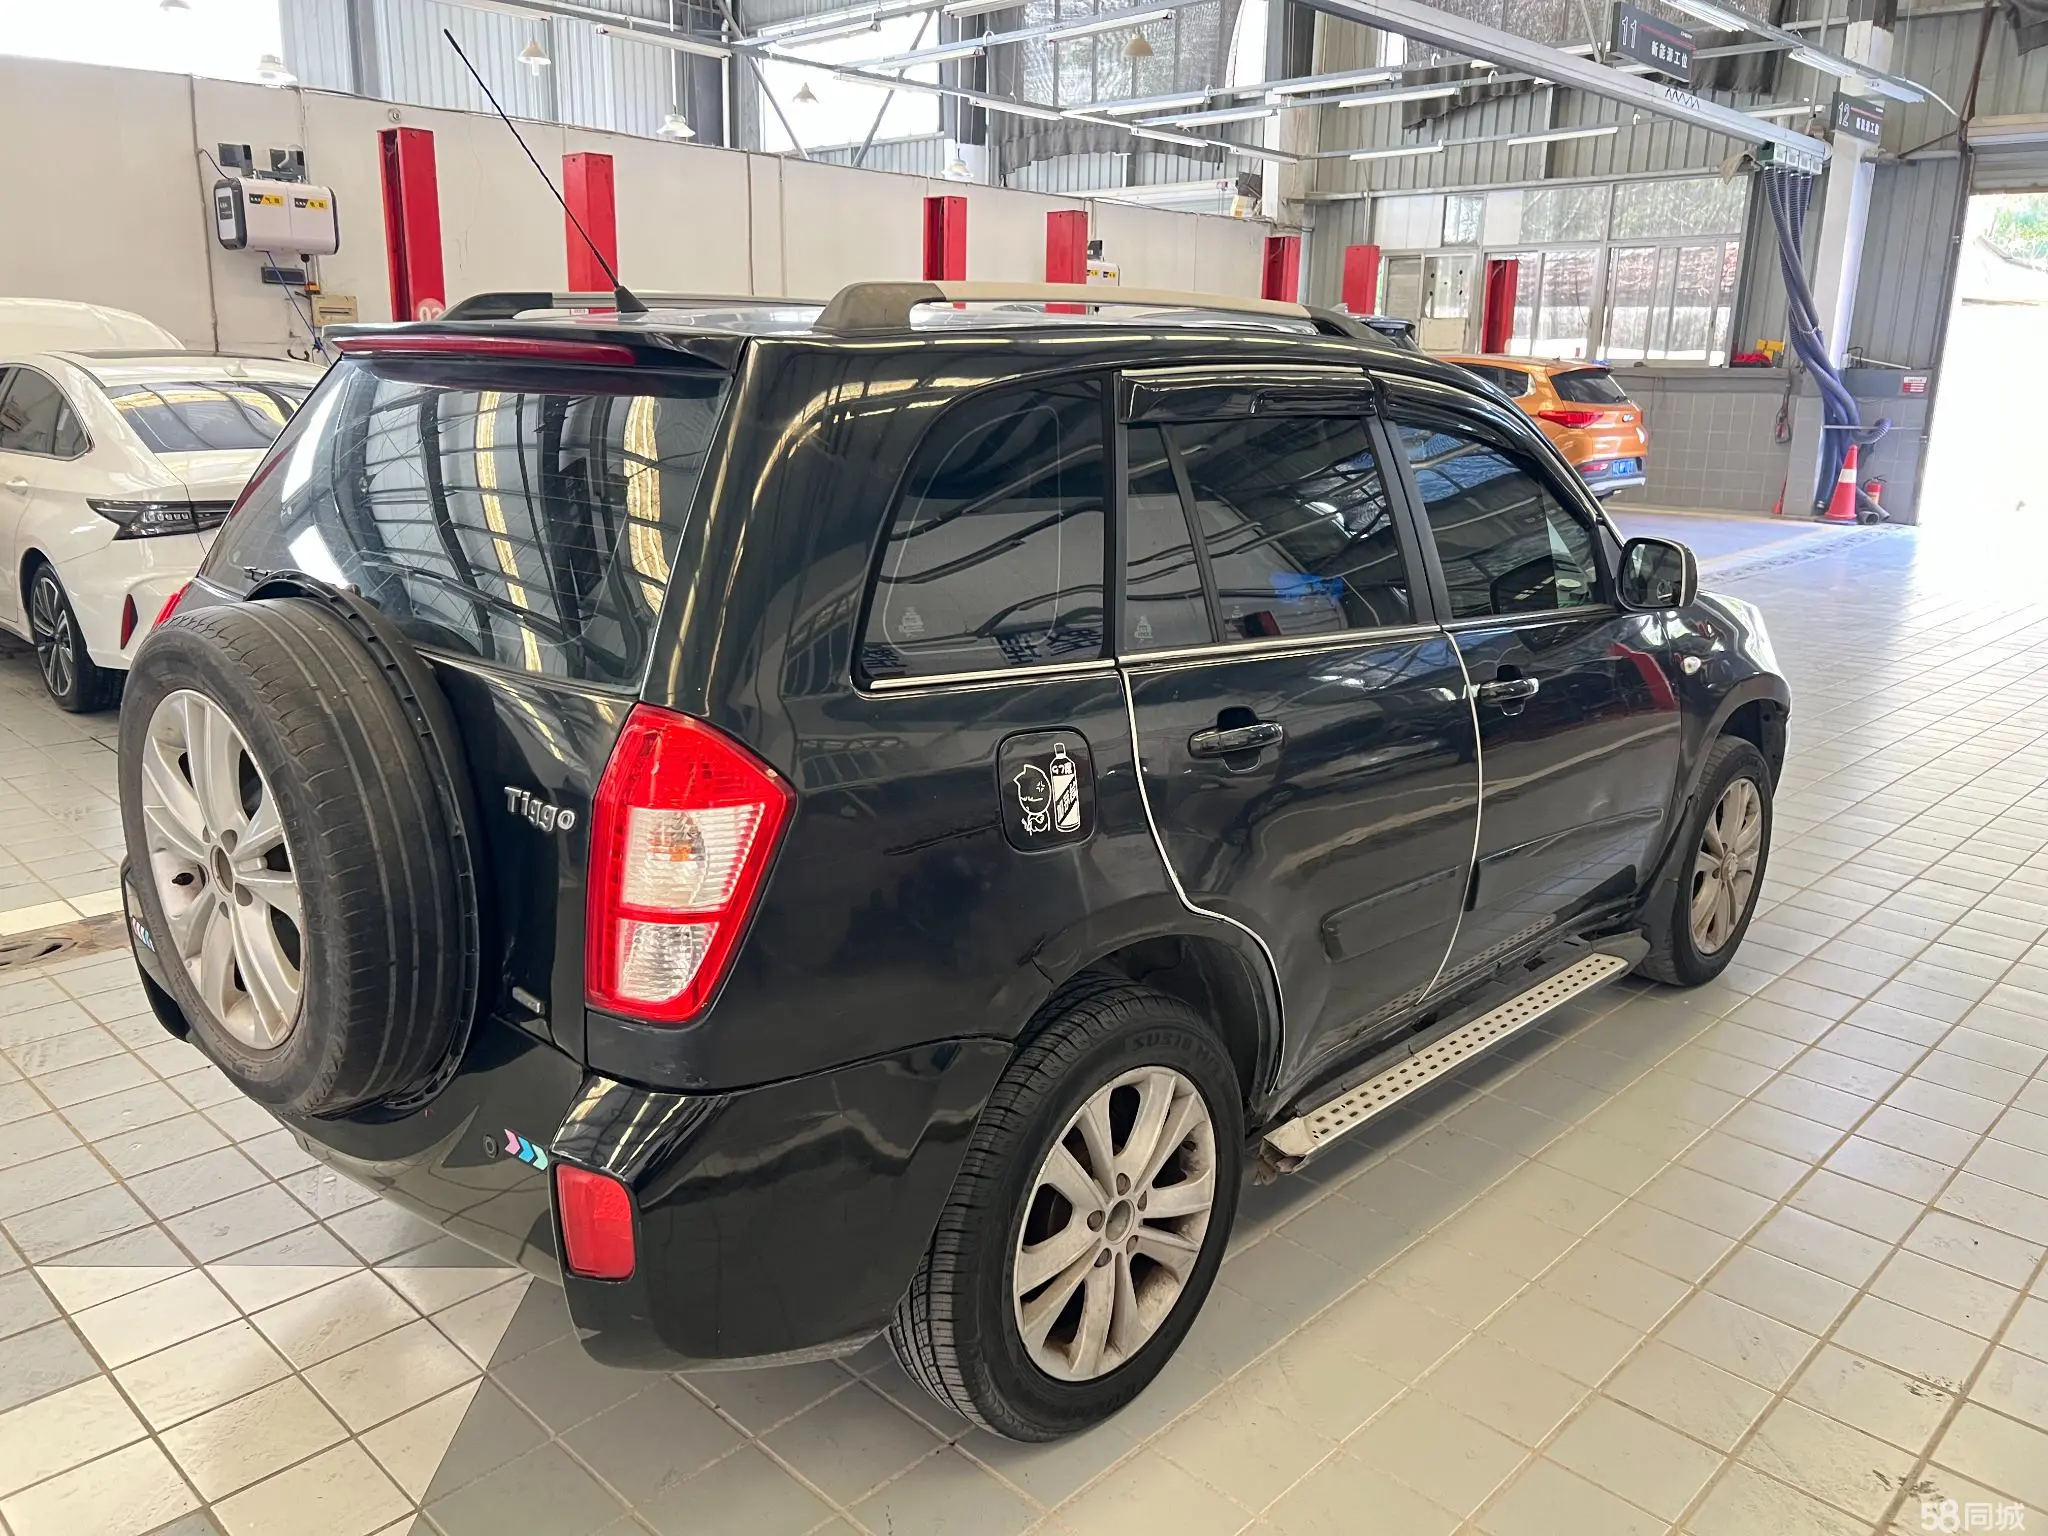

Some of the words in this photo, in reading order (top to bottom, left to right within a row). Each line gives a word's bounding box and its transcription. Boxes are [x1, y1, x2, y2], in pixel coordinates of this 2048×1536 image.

[1622, 15, 1637, 48] 11
[1651, 40, 1688, 68] 新能源工位
[1838, 101, 1850, 127] 12
[504, 786, 576, 832] Tiggo
